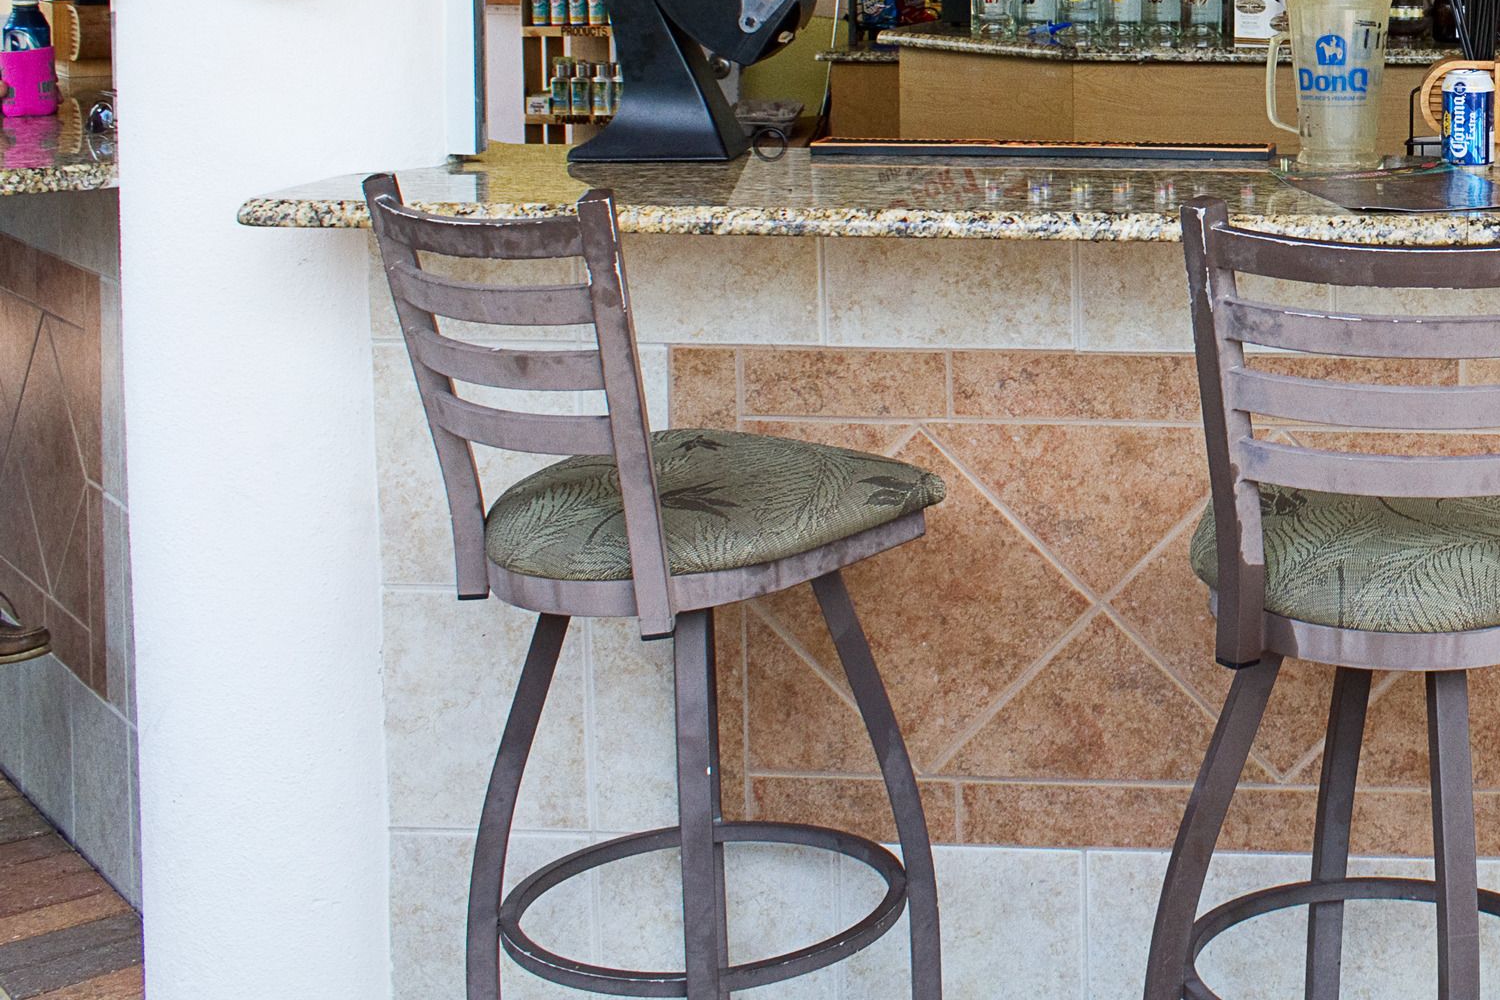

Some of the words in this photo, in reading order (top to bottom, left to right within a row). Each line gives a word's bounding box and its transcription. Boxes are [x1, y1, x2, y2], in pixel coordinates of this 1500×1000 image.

[560, 26, 609, 37] PRODUCTS
[1298, 67, 1369, 93] DonQ
[1450, 94, 1469, 158] Corona
[1465, 111, 1476, 140] Extra
